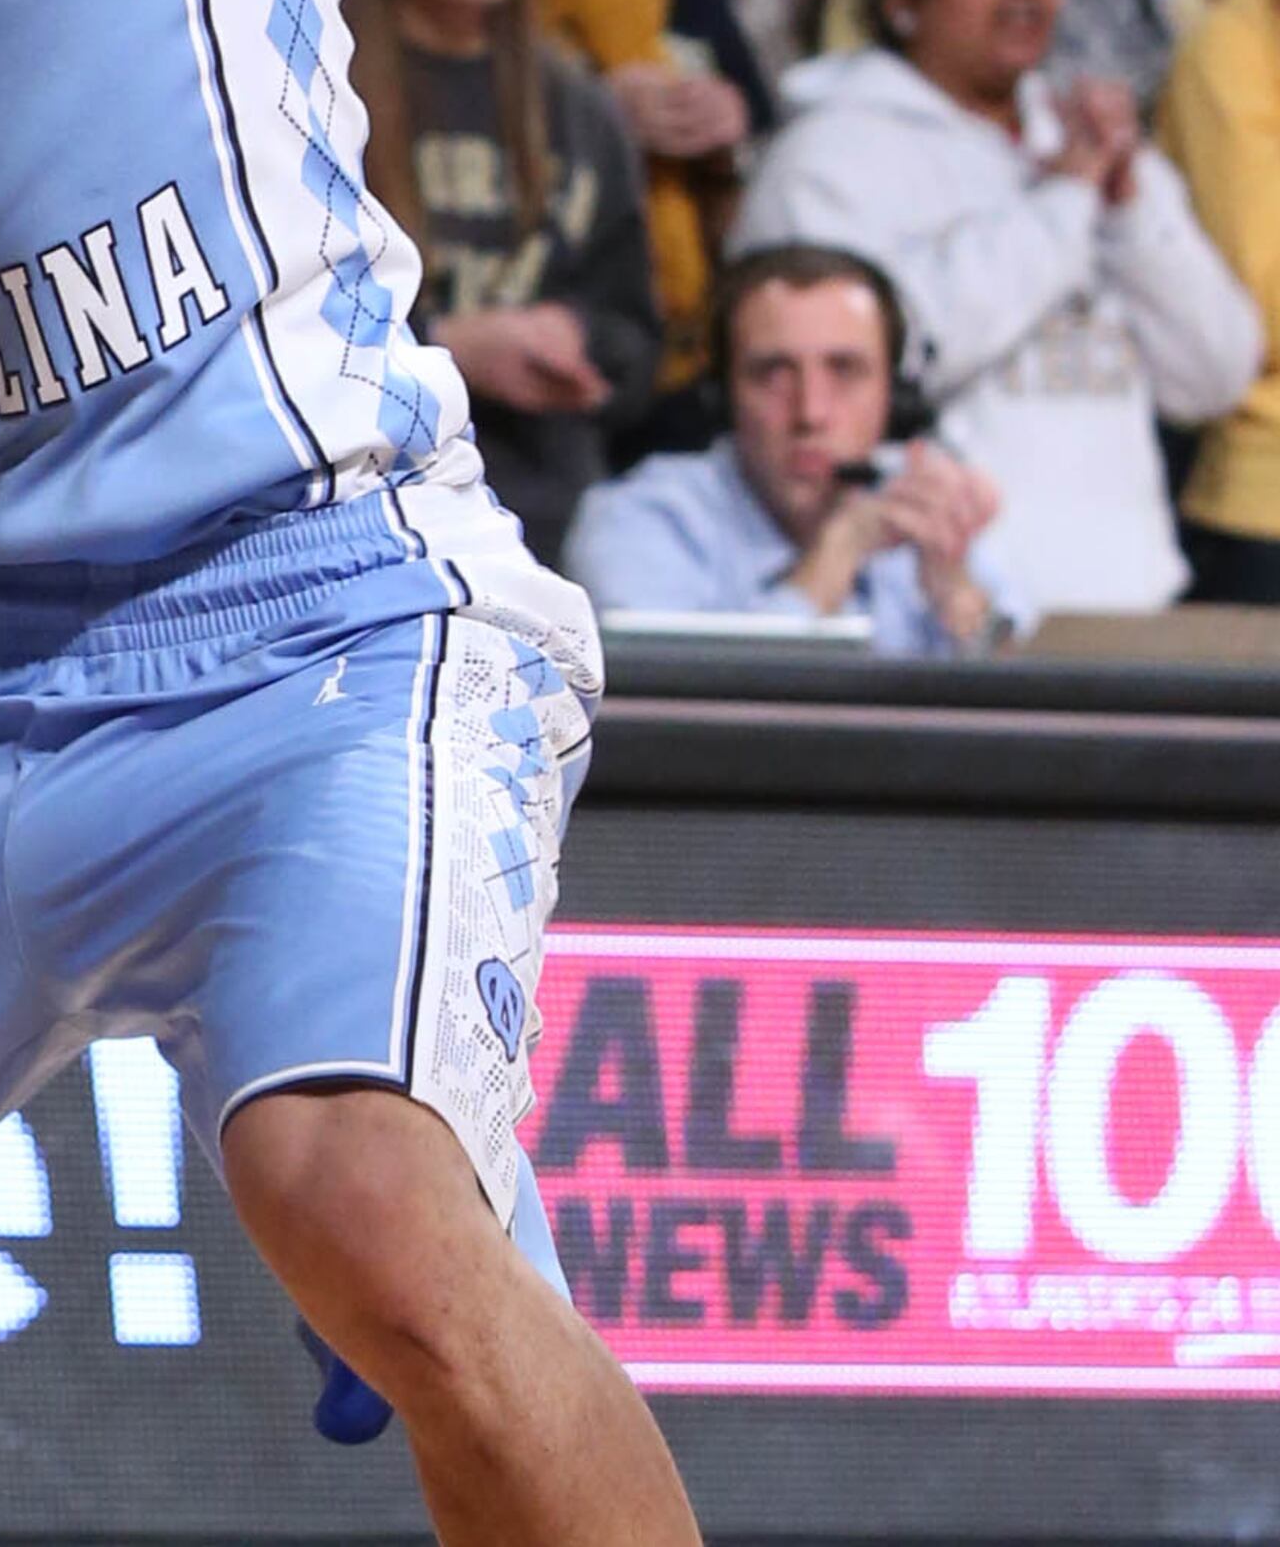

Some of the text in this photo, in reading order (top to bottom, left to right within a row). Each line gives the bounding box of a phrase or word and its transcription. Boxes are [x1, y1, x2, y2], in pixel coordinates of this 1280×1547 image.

[536, 974, 897, 1172] ALL
[922, 967, 1280, 1264] 10
[552, 1196, 913, 1331] NEWS
